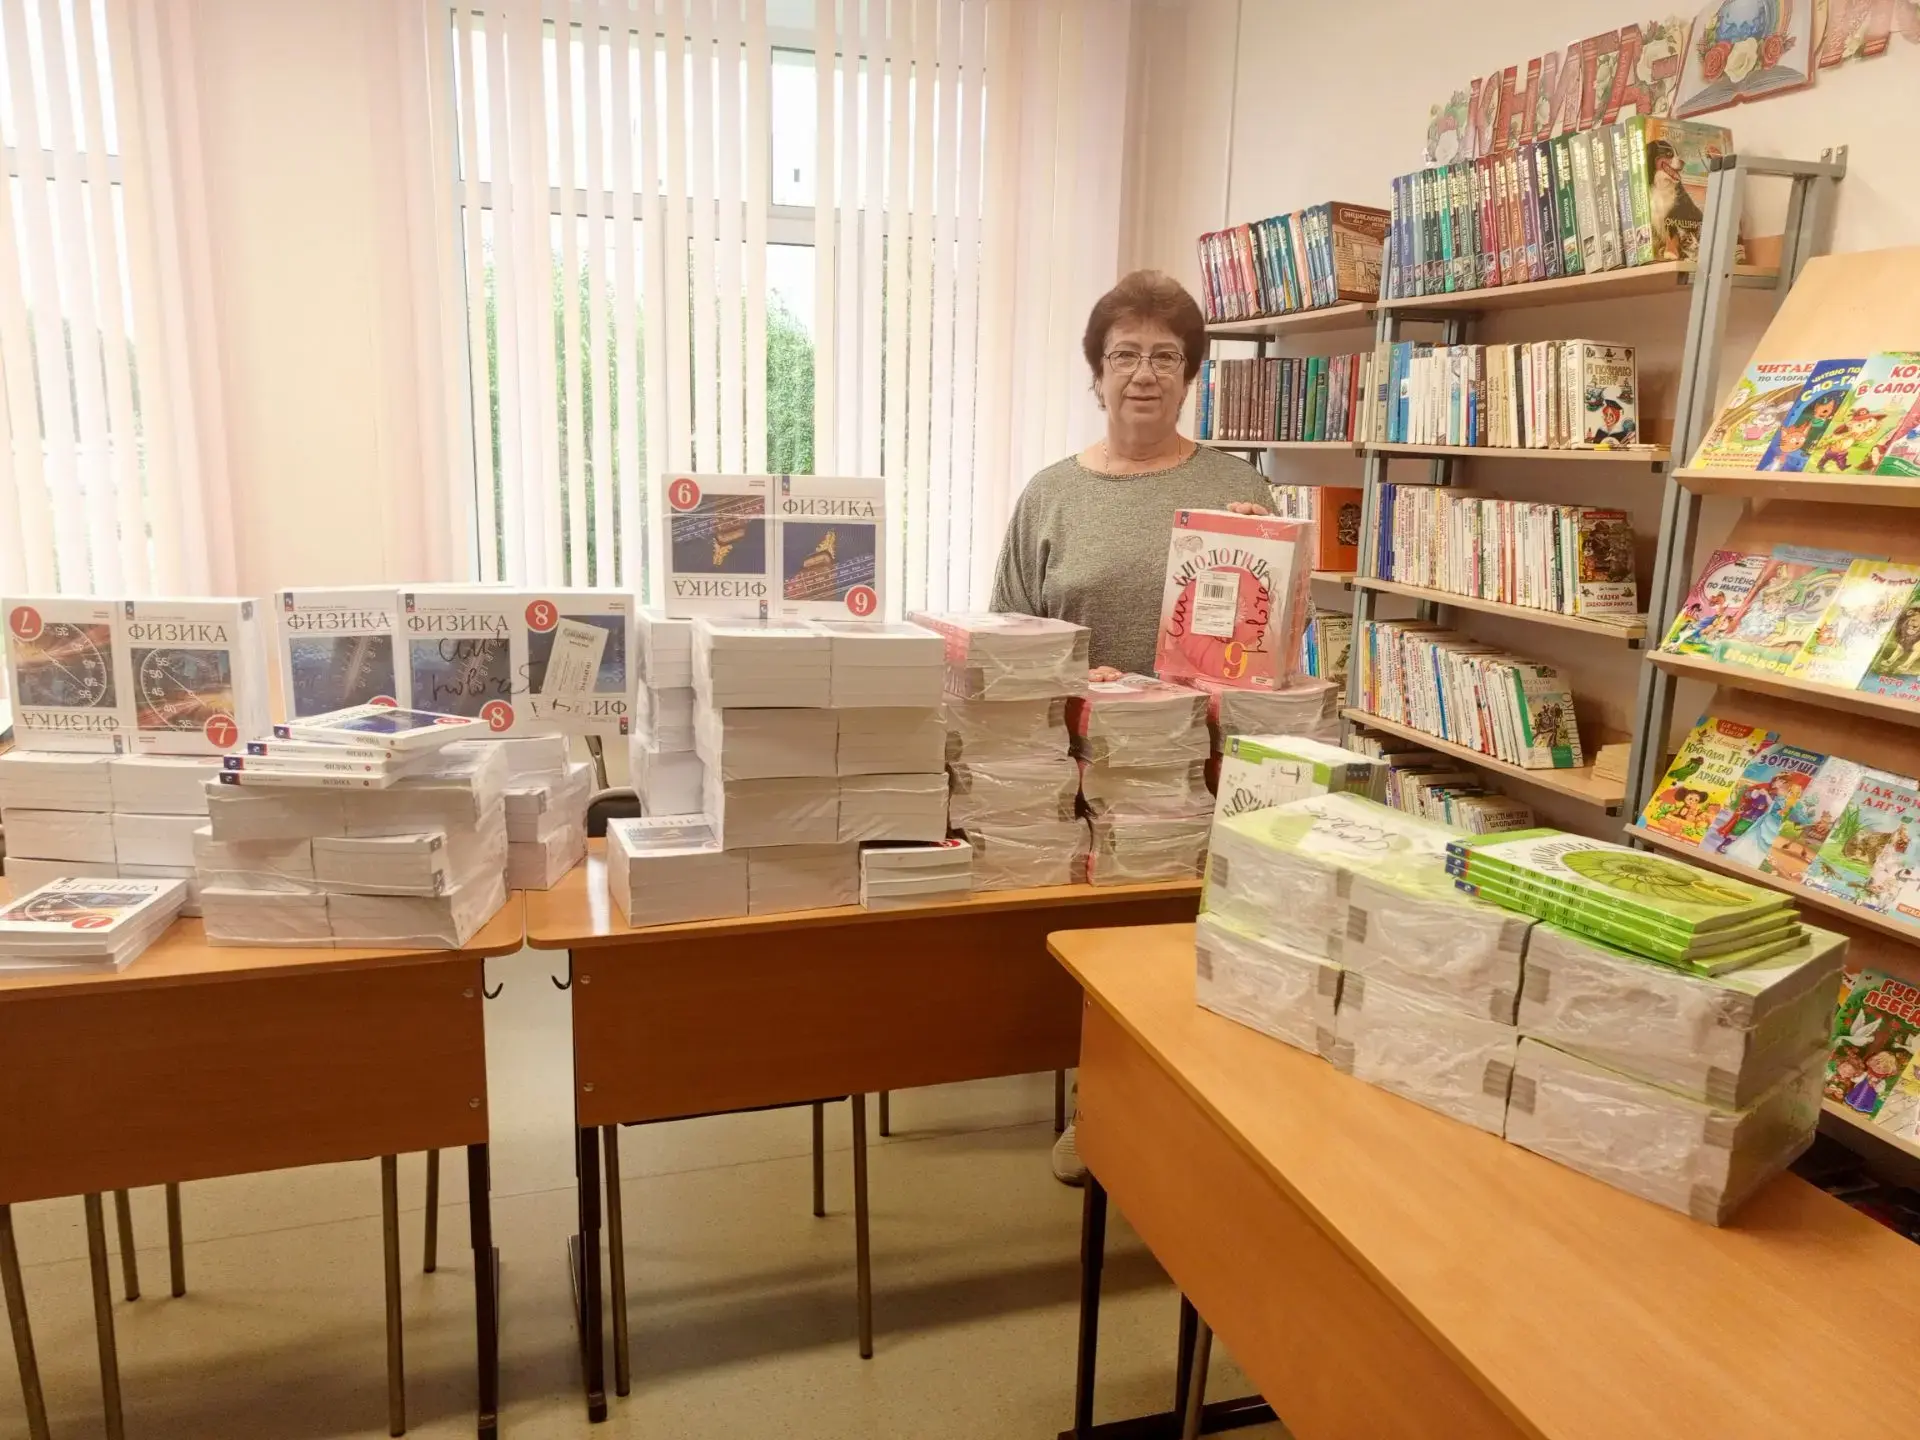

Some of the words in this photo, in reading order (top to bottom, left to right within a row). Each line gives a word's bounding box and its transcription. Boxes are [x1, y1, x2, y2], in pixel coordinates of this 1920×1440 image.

[1857, 385, 1869, 396] В
[782, 499, 876, 517] ФИЗИКА
[673, 580, 767, 597] ФИЗИКА
[855, 592, 868, 613] 9
[20, 611, 33, 633] 7
[287, 611, 393, 631] ФИЗИКА
[407, 615, 511, 633] ФИЗИКА
[535, 603, 549, 627] 8
[128, 623, 229, 644] ФИЗИКА
[155, 657, 169, 667] 55
[1222, 641, 1248, 680] 9
[149, 668, 164, 680] 50
[151, 687, 165, 697] 45
[22, 712, 120, 733] ФИЗИКА
[491, 707, 504, 730] 8
[214, 722, 229, 745] 7
[1857, 781, 1895, 799] КАК
